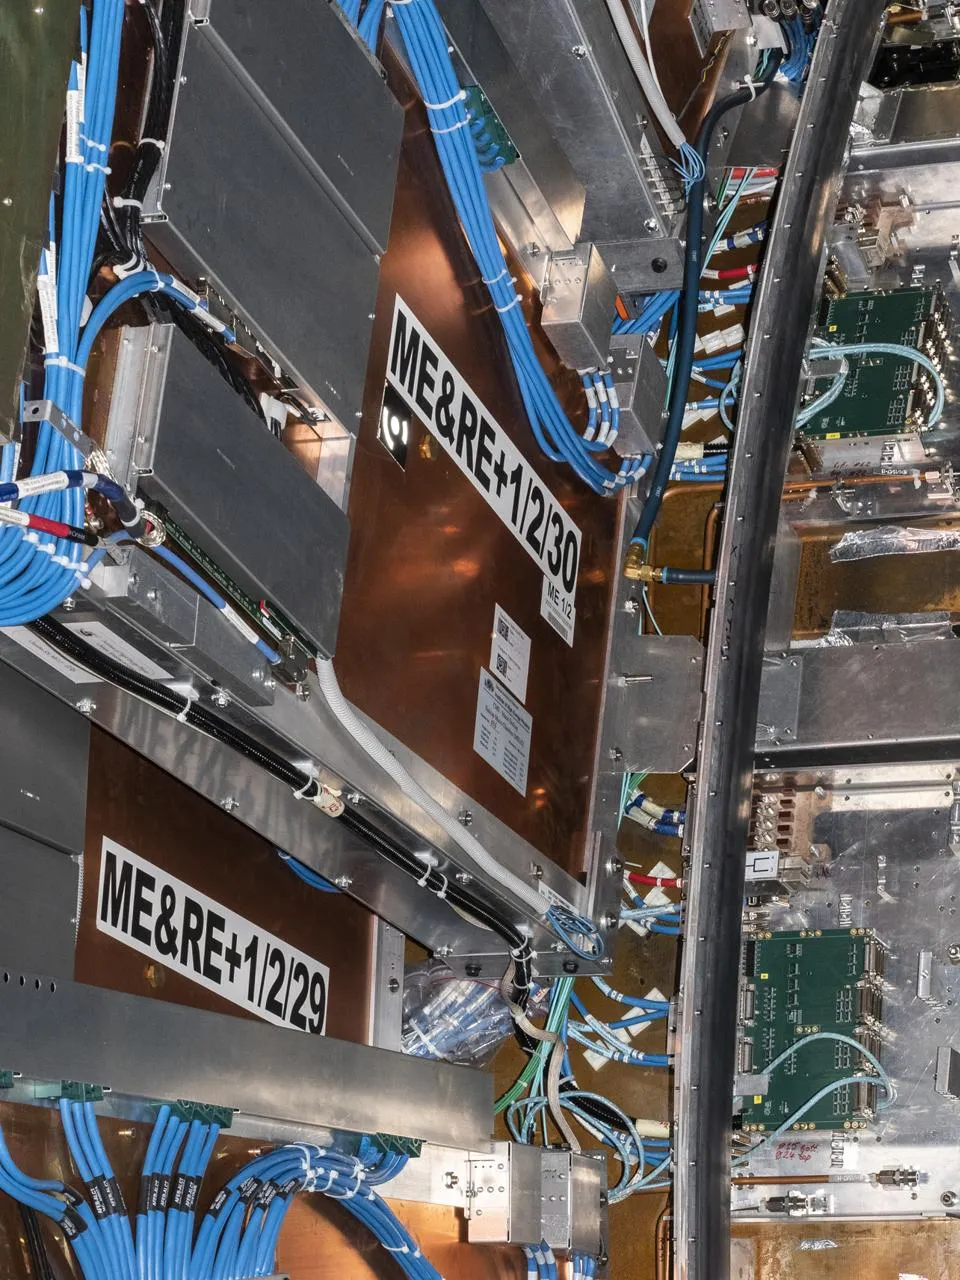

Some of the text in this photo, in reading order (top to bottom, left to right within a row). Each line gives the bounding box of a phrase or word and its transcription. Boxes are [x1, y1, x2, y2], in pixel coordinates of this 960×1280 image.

[390, 308, 578, 594] ME&RE+1/2/30
[547, 581, 560, 606] ME
[562, 598, 572, 620] 1/2
[100, 850, 326, 1036] ME&RE+1/2/29
